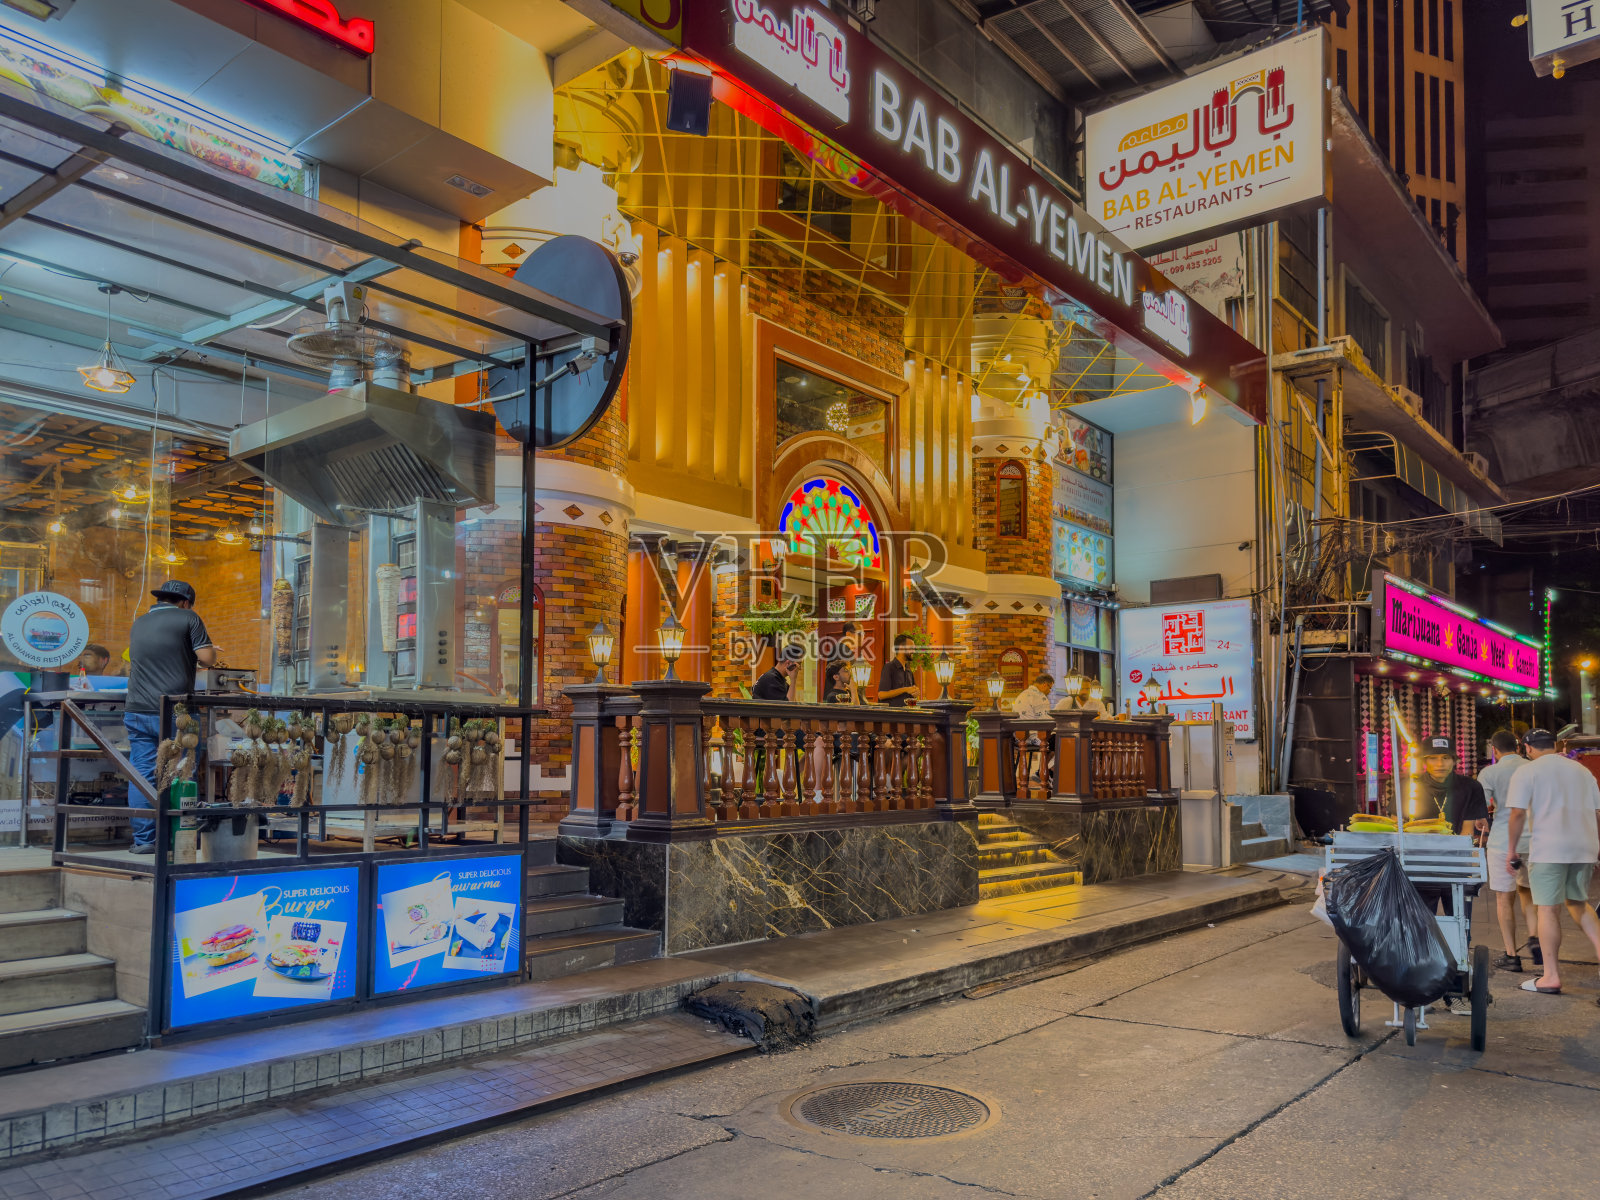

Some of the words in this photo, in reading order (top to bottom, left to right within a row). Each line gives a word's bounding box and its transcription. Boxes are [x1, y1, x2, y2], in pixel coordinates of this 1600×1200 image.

[874, 70, 962, 184] BAB
[971, 149, 1134, 307] AL-YEMEN
[1103, 188, 1150, 221] BAB
[1157, 140, 1295, 205] AL-YEMEN
[1135, 183, 1254, 230] RESTAURANTS
[1186, 261, 1201, 270] 435
[1202, 256, 1222, 267] 5205
[7, 632, 15, 642] AL
[12, 642, 41, 662] GHAWAS
[43, 637, 83, 663] RESTAURANT
[1217, 640, 1230, 650] 24
[1392, 598, 1440, 647] Marijuana
[1457, 624, 1477, 660] Ganja
[1491, 640, 1506, 670] Weed
[1187, 659, 1218, 670] مطعم
[479, 868, 512, 877] DELICIOUS
[256, 886, 335, 919] Burger
[283, 889, 308, 899] SUPER
[309, 885, 350, 896] DELICIOUS
